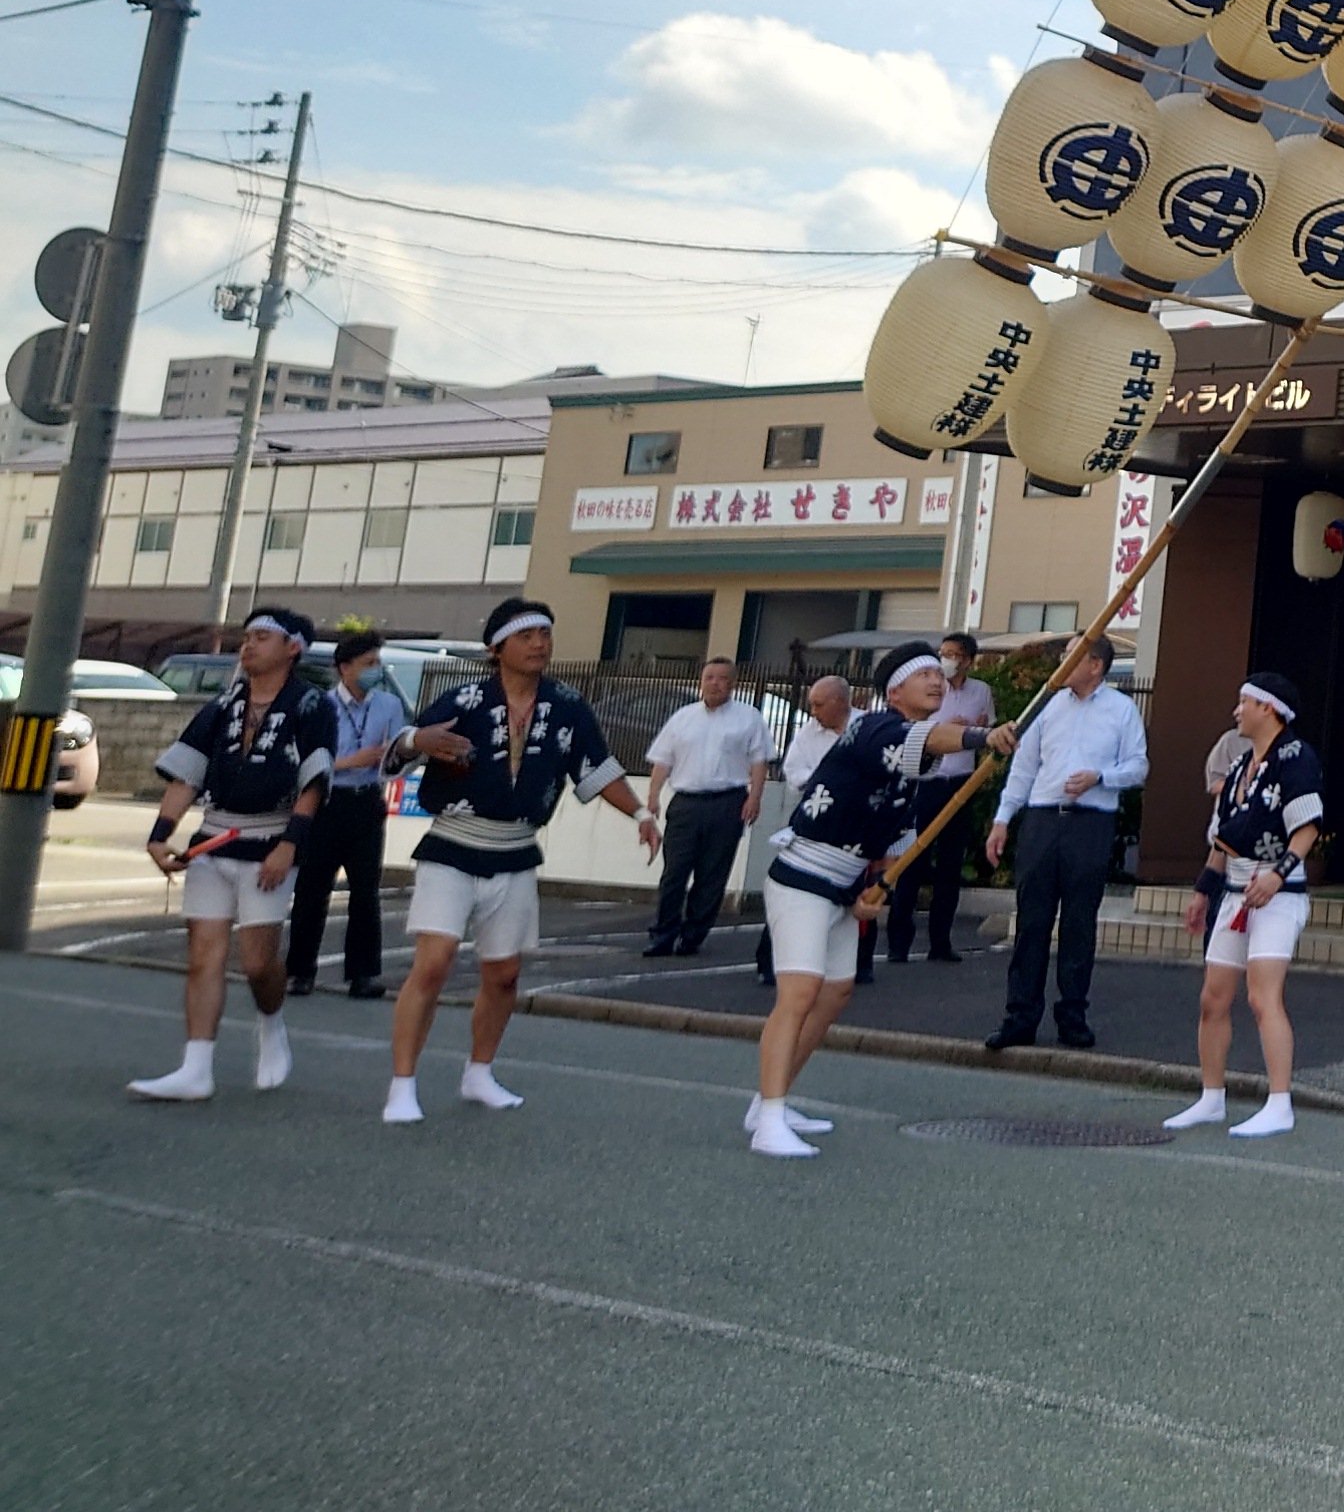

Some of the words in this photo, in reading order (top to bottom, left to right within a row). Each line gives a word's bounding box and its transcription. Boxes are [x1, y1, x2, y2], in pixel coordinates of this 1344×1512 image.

[676, 490, 773, 524] 株式会社
[791, 482, 898, 521] せきや
[926, 489, 952, 512] 秋田
